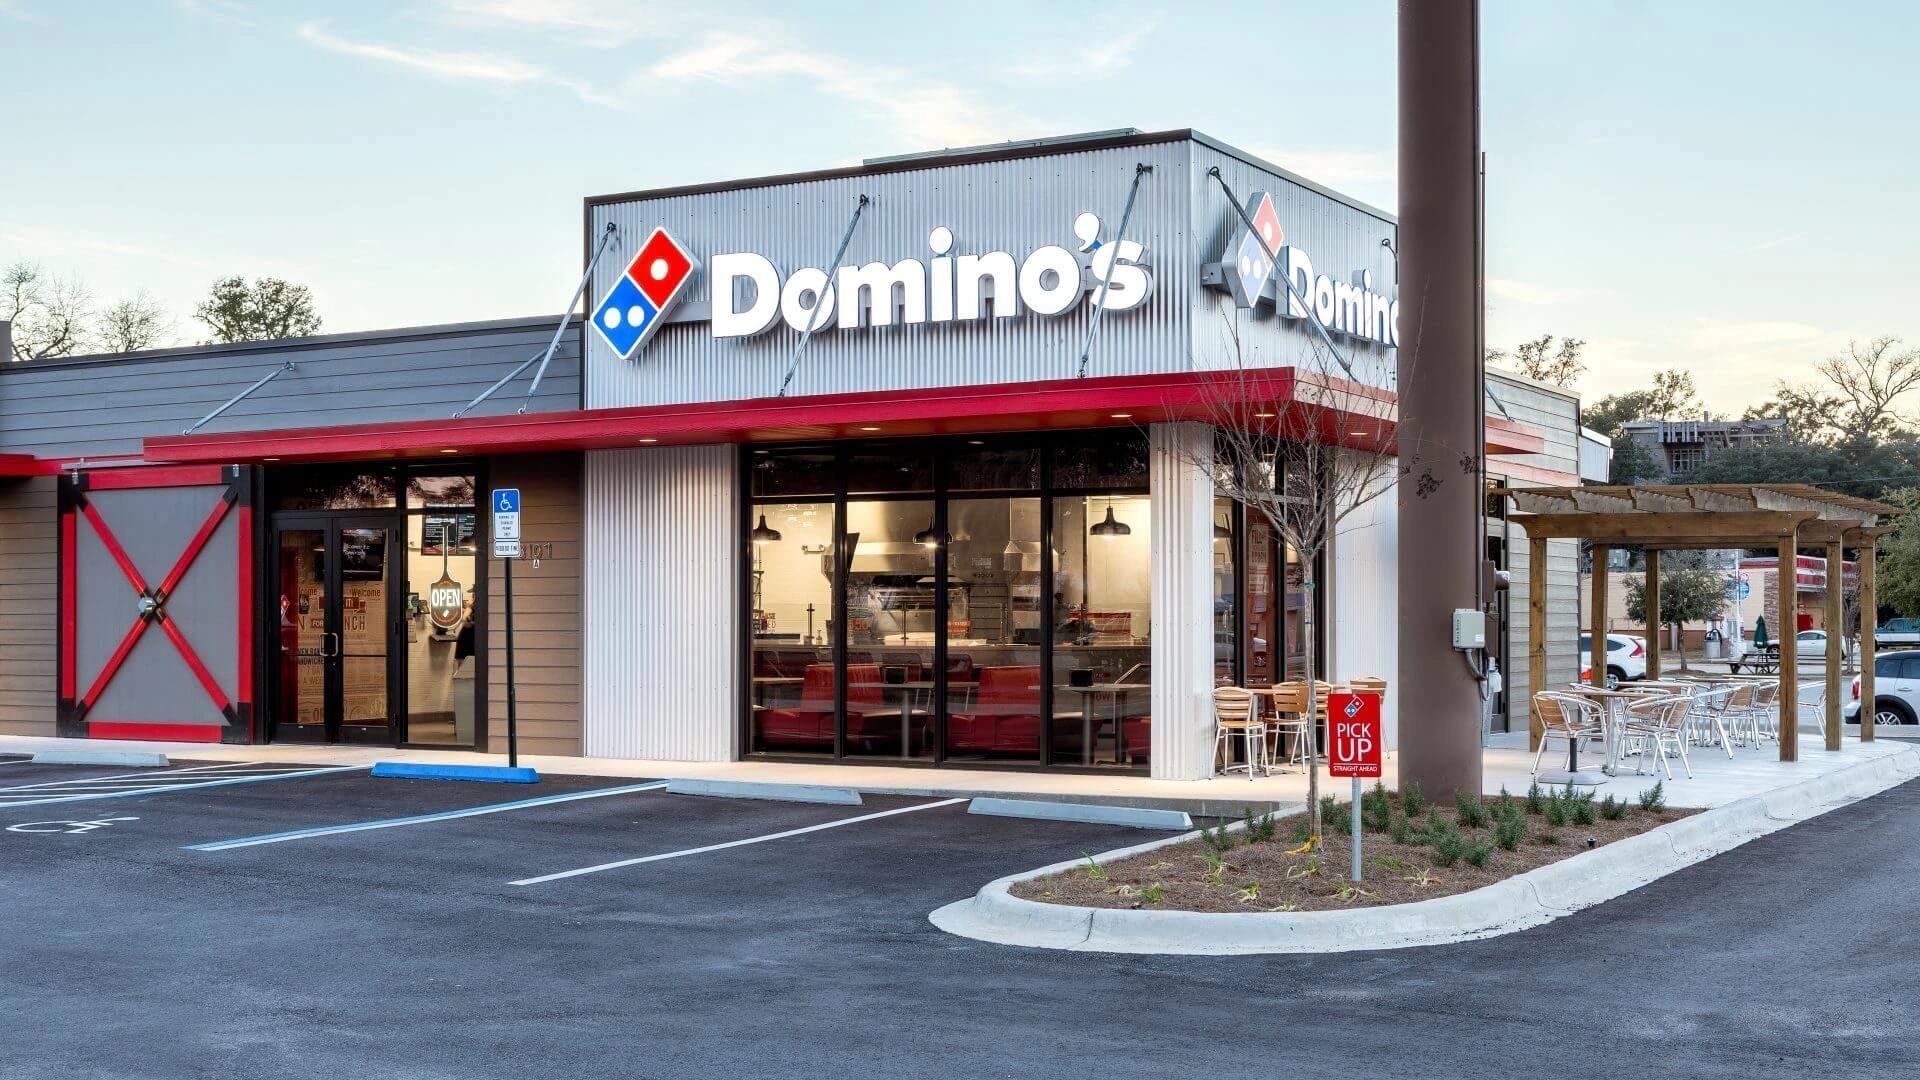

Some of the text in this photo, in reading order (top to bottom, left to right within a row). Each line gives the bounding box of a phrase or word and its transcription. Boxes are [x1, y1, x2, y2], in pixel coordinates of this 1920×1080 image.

[711, 211, 1152, 338] Domino's
[432, 588, 460, 607] OPEN
[1337, 723, 1372, 738] PICK
[1337, 738, 1373, 762] UP
